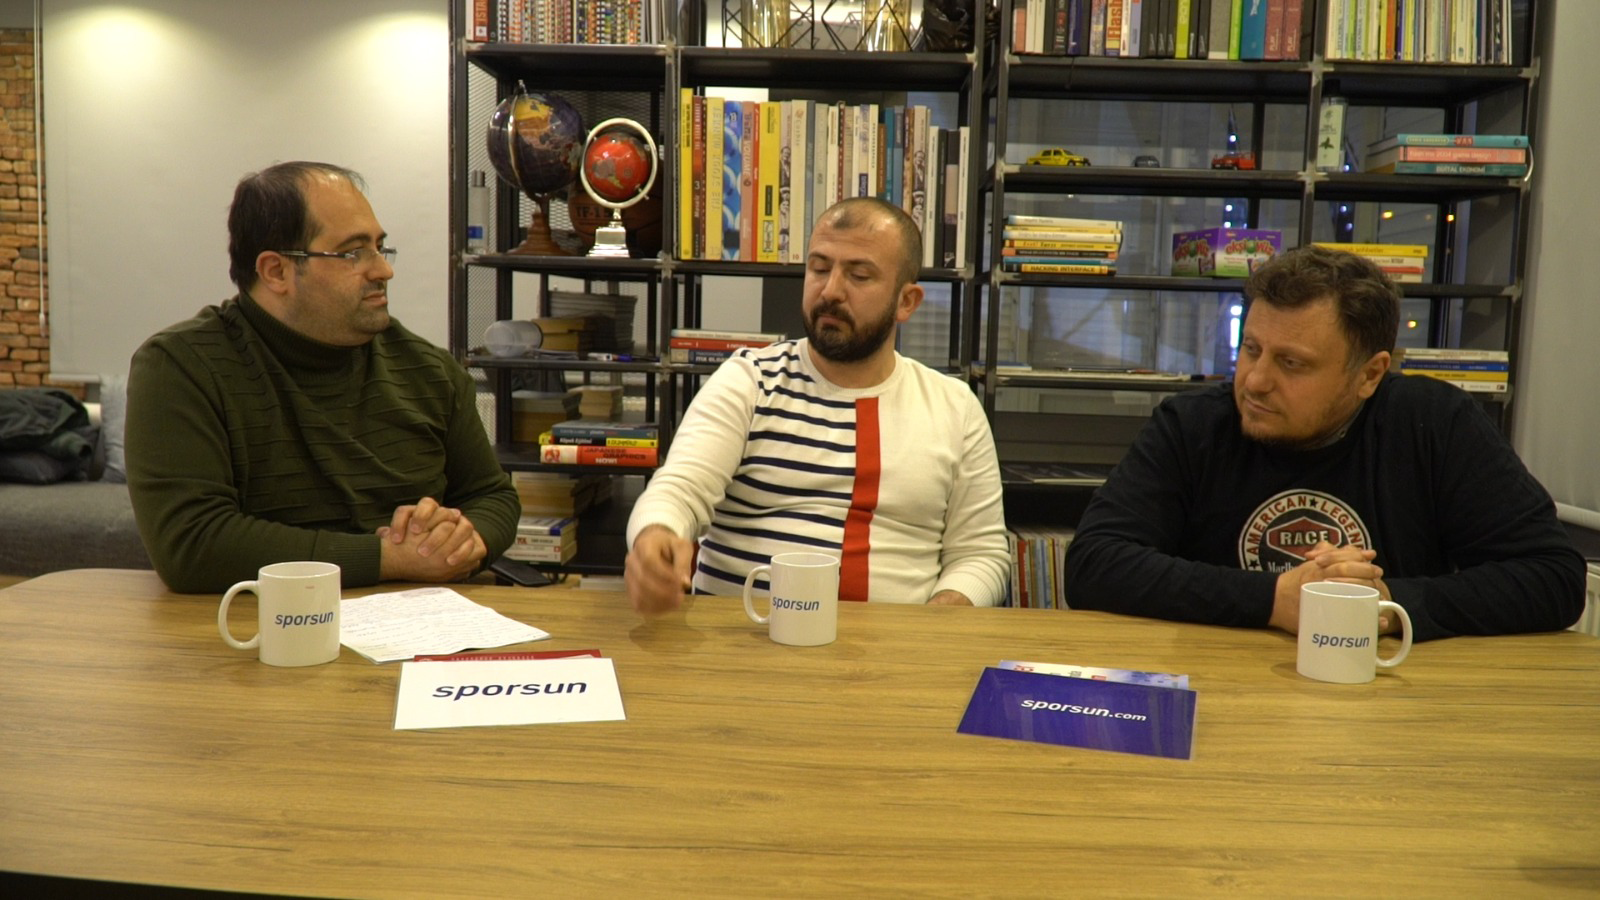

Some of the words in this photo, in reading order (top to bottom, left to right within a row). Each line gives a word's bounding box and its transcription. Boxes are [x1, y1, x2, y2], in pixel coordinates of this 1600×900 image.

[711, 106, 722, 150] MARKET
[742, 139, 752, 176] VOLUME
[711, 155, 722, 187] STOCK
[711, 192, 722, 212] THE
[1246, 495, 1307, 556] AMERICAN
[1279, 530, 1329, 545] RACE
[1267, 561, 1297, 573] Marlb
[772, 596, 820, 612] sporsun
[274, 611, 334, 629] sporsun
[1311, 632, 1370, 648] sporsun
[431, 681, 588, 701] sporsun
[1020, 698, 1147, 722] sporsun.com
